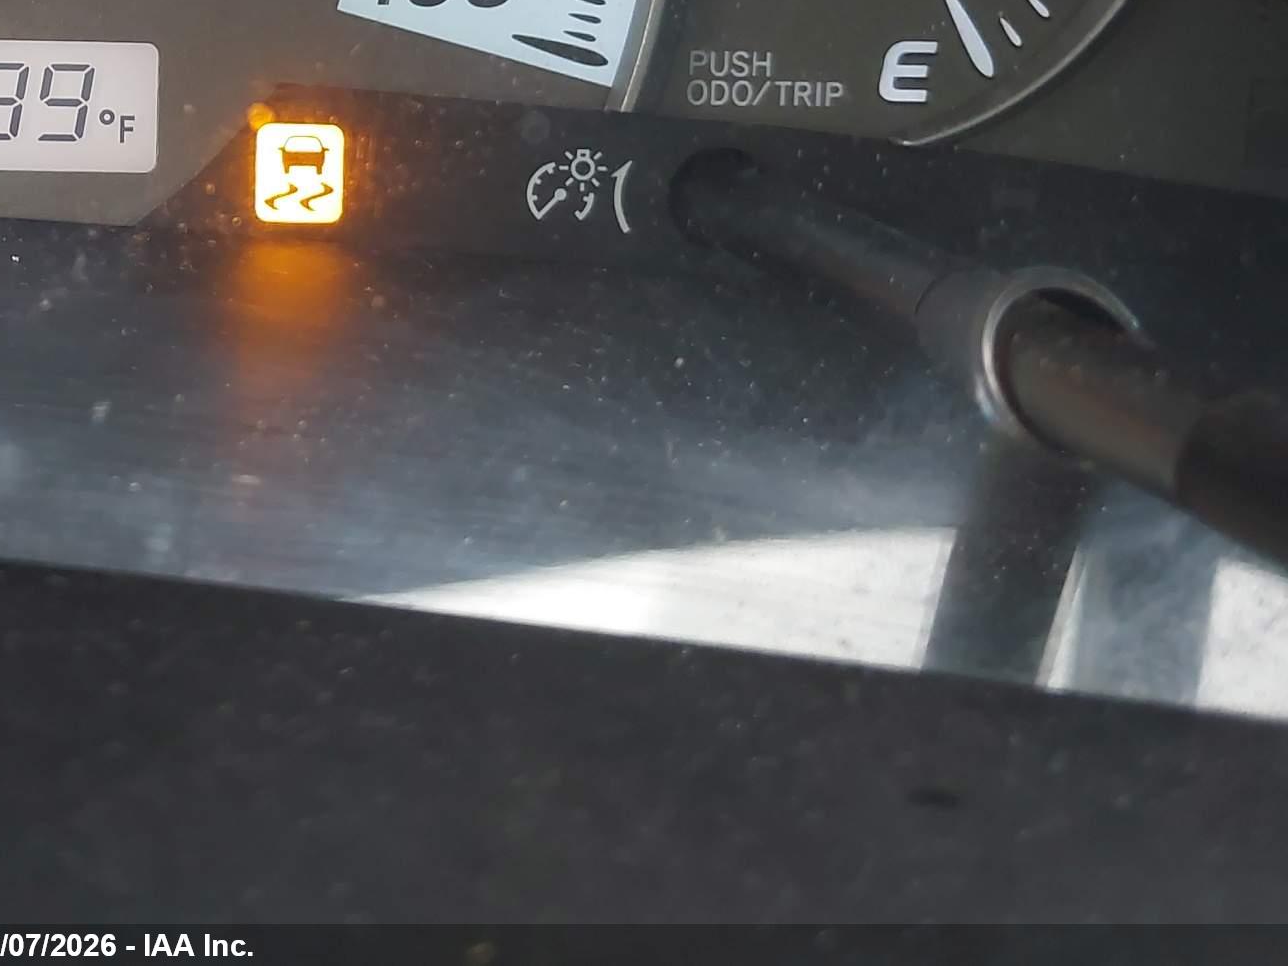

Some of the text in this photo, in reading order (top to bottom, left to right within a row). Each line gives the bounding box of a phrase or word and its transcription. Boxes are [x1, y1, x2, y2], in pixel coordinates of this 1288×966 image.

[689, 50, 773, 78] PUSH
[878, 40, 939, 104] E
[686, 79, 845, 109] ODO/TRIP
